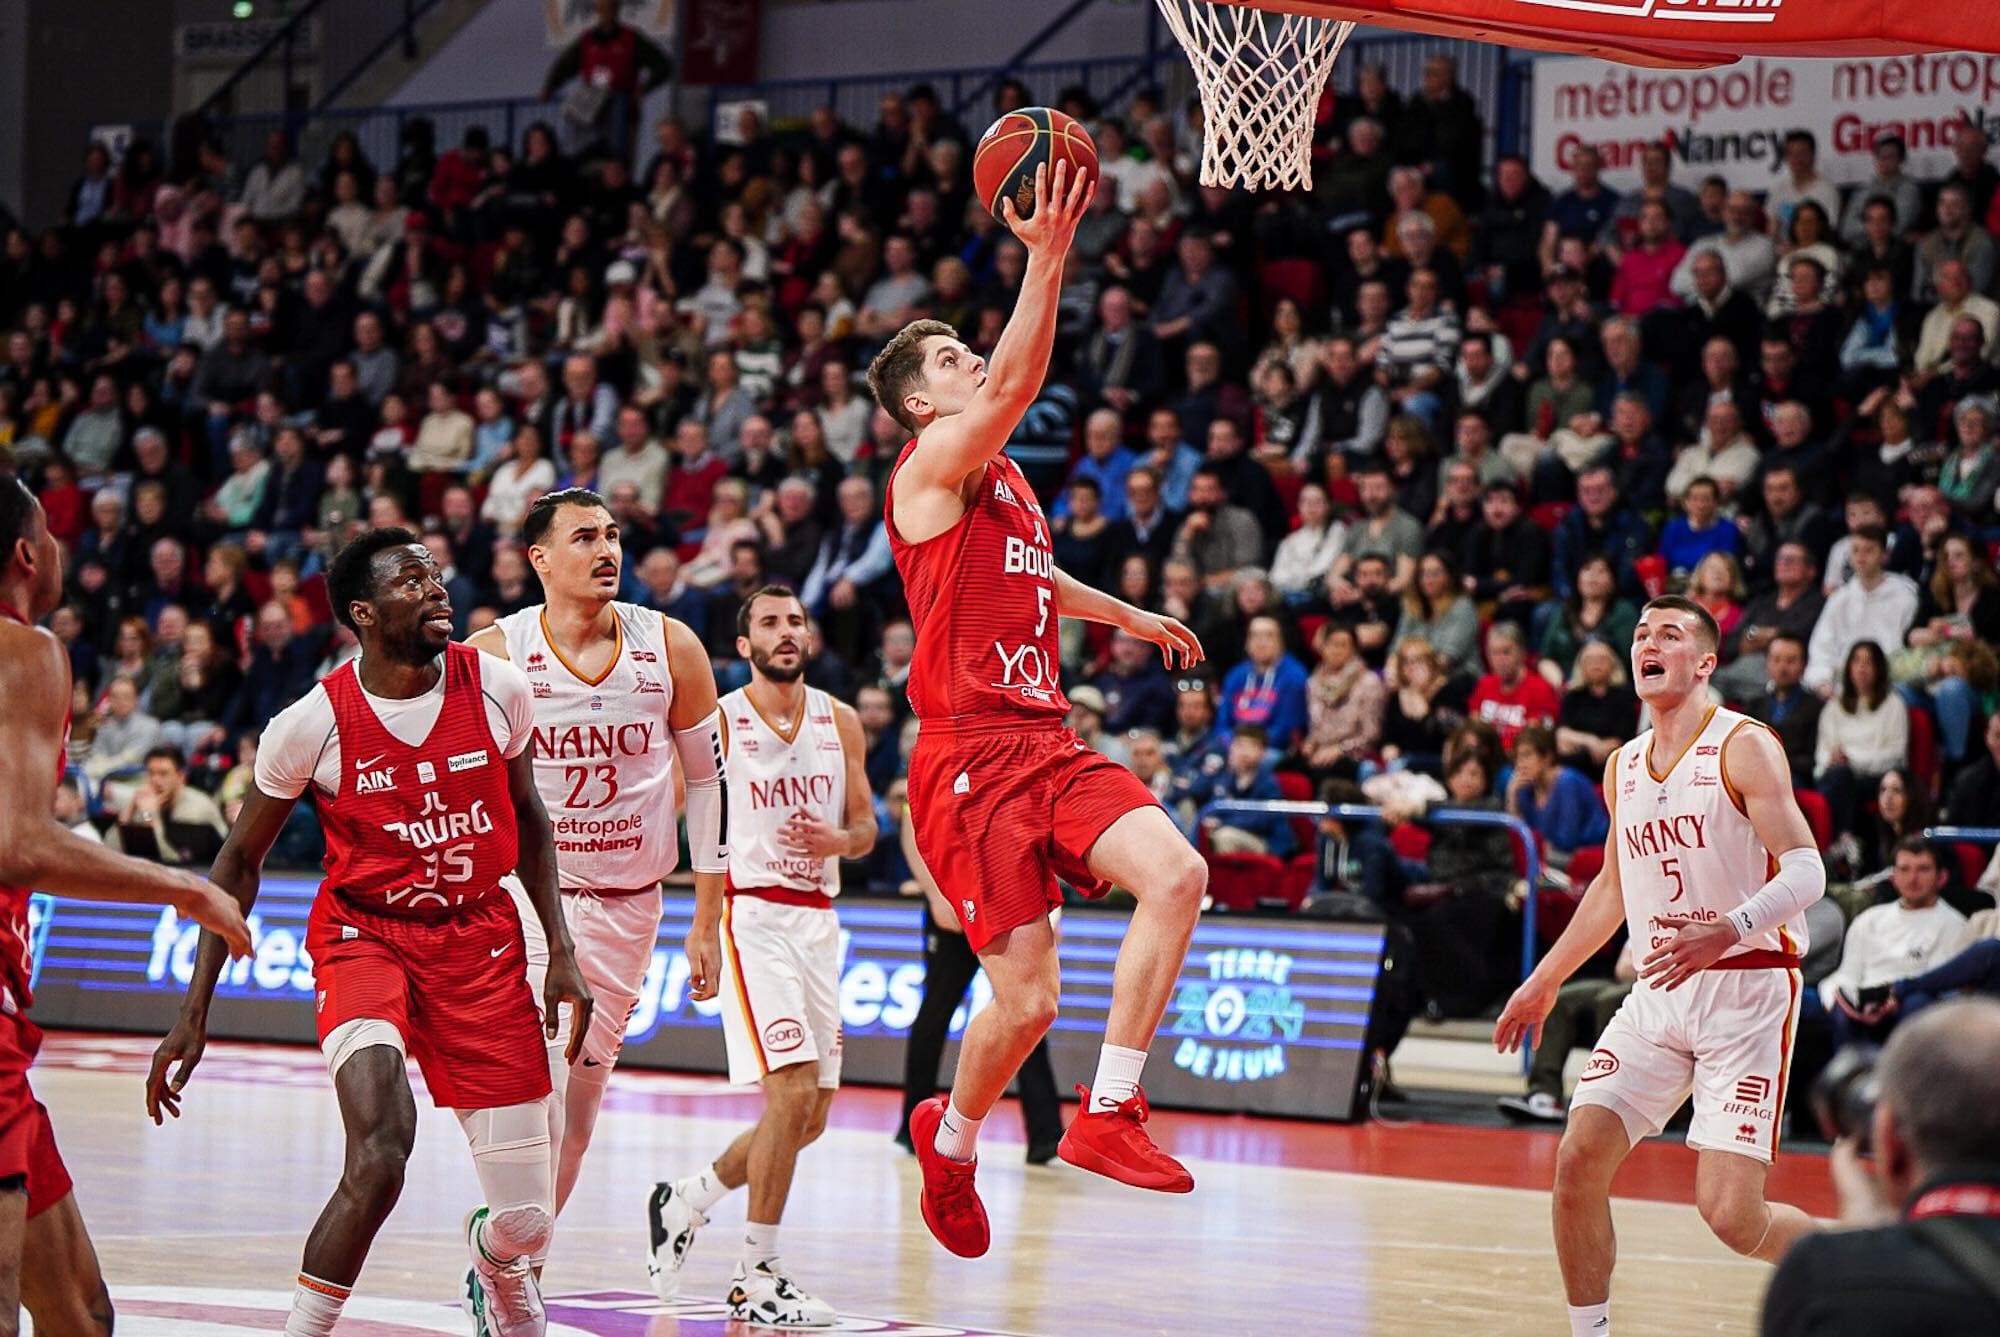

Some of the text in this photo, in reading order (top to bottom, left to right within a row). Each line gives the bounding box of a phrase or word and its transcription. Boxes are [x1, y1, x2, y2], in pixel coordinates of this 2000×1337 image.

[1555, 60, 1793, 120] métropole
[1035, 585, 1052, 638] 5
[531, 721, 654, 760] NANCY
[356, 770, 394, 792] AIN
[564, 764, 618, 809] 23
[749, 775, 835, 810] NANCY
[551, 814, 642, 837] étropole
[1625, 814, 1706, 860] NANCY
[554, 834, 643, 853] randNancy
[1660, 857, 1684, 903] 5
[766, 1027, 802, 1045] cora
[1586, 1058, 1615, 1071] ora
[1723, 1102, 1774, 1120] EIFFAGE
